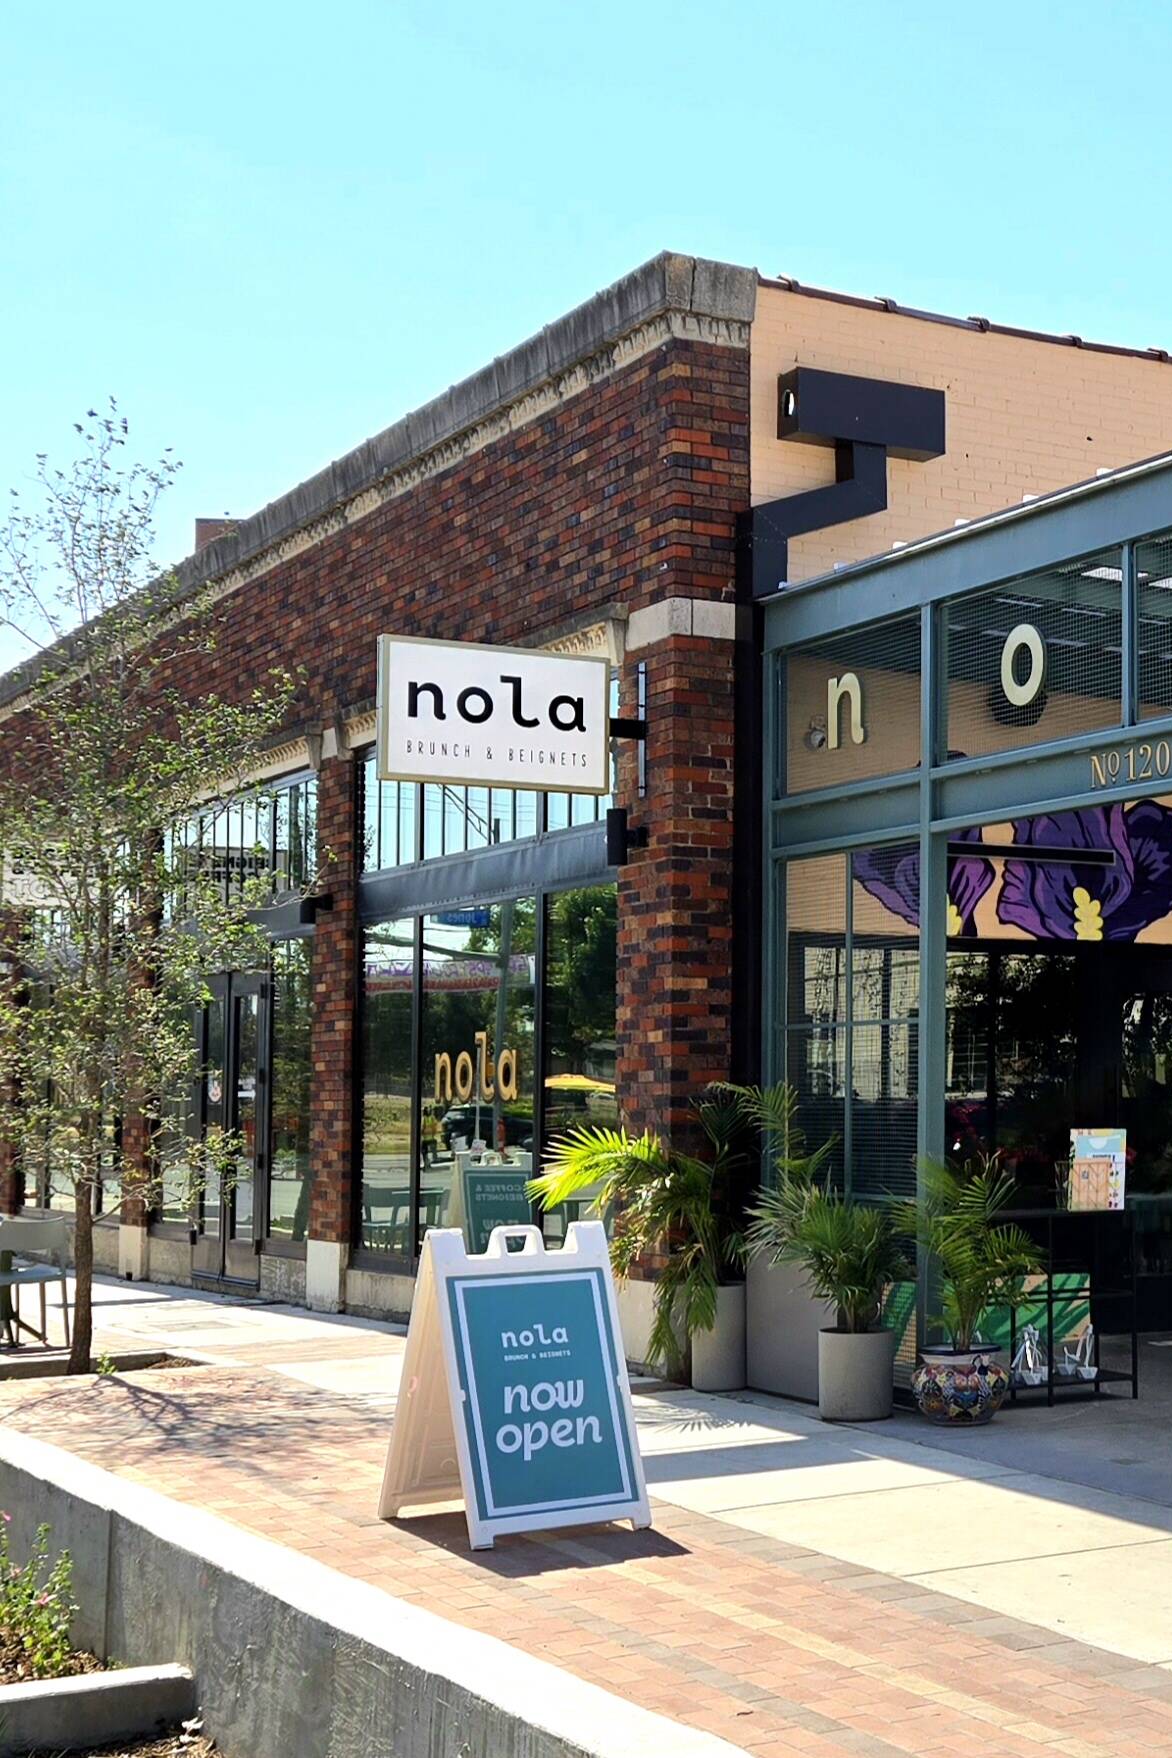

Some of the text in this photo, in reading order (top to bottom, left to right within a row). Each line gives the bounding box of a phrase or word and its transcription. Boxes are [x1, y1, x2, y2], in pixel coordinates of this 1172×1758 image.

[407, 675, 587, 733] nola
[407, 740, 588, 767] BRUNCH & BEIGNETS
[434, 1031, 518, 1104] nola
[501, 1324, 569, 1348] nola
[503, 1379, 585, 1414] now
[495, 1415, 603, 1461] open
